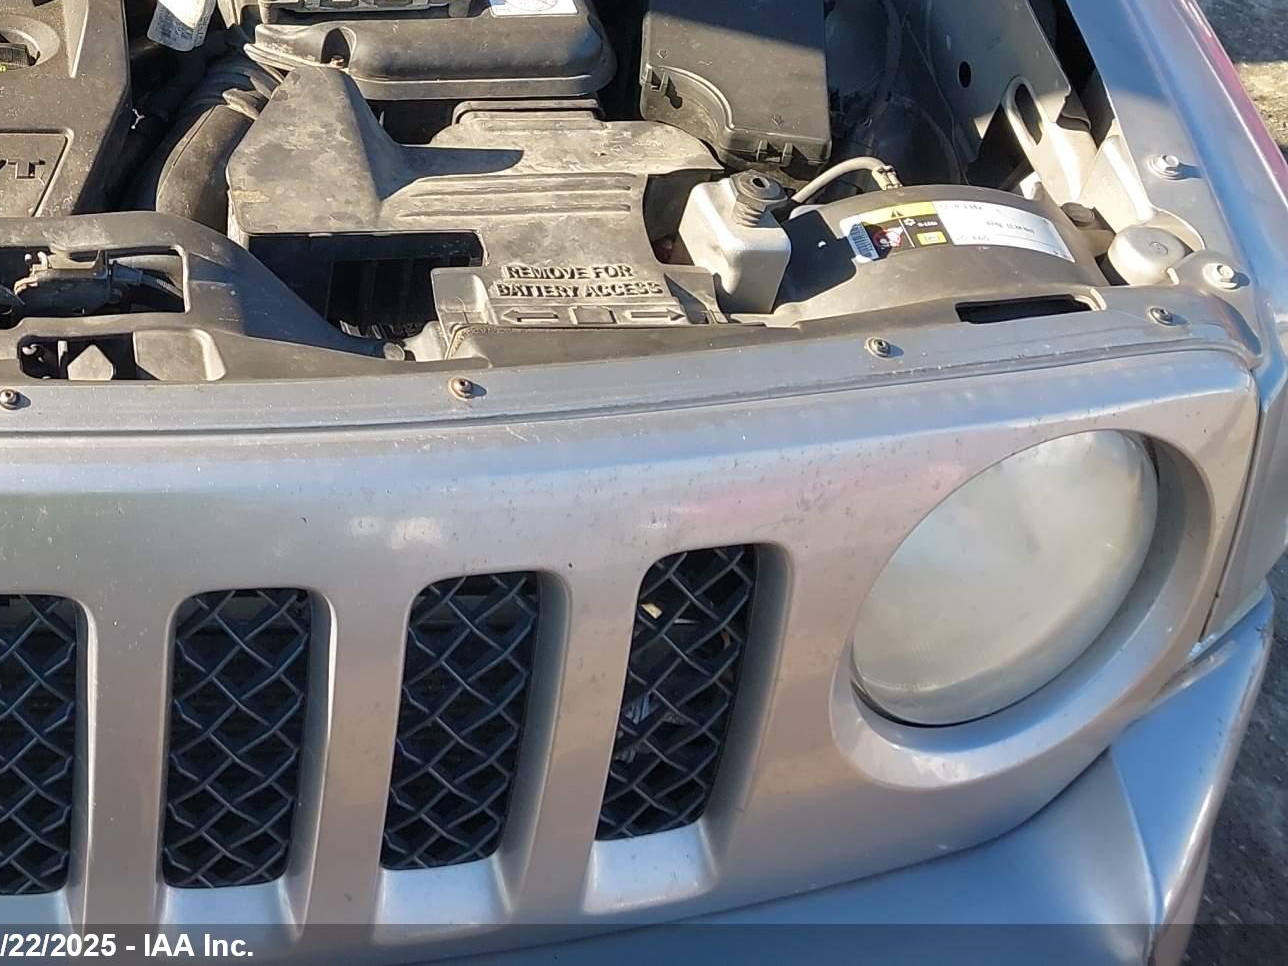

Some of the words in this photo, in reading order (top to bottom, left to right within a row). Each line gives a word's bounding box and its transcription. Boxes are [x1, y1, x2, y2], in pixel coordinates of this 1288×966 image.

[502, 265, 590, 280] REMOVE
[592, 264, 634, 279] FOR
[492, 281, 581, 298] BATTERY
[583, 281, 665, 297] ACCESS
